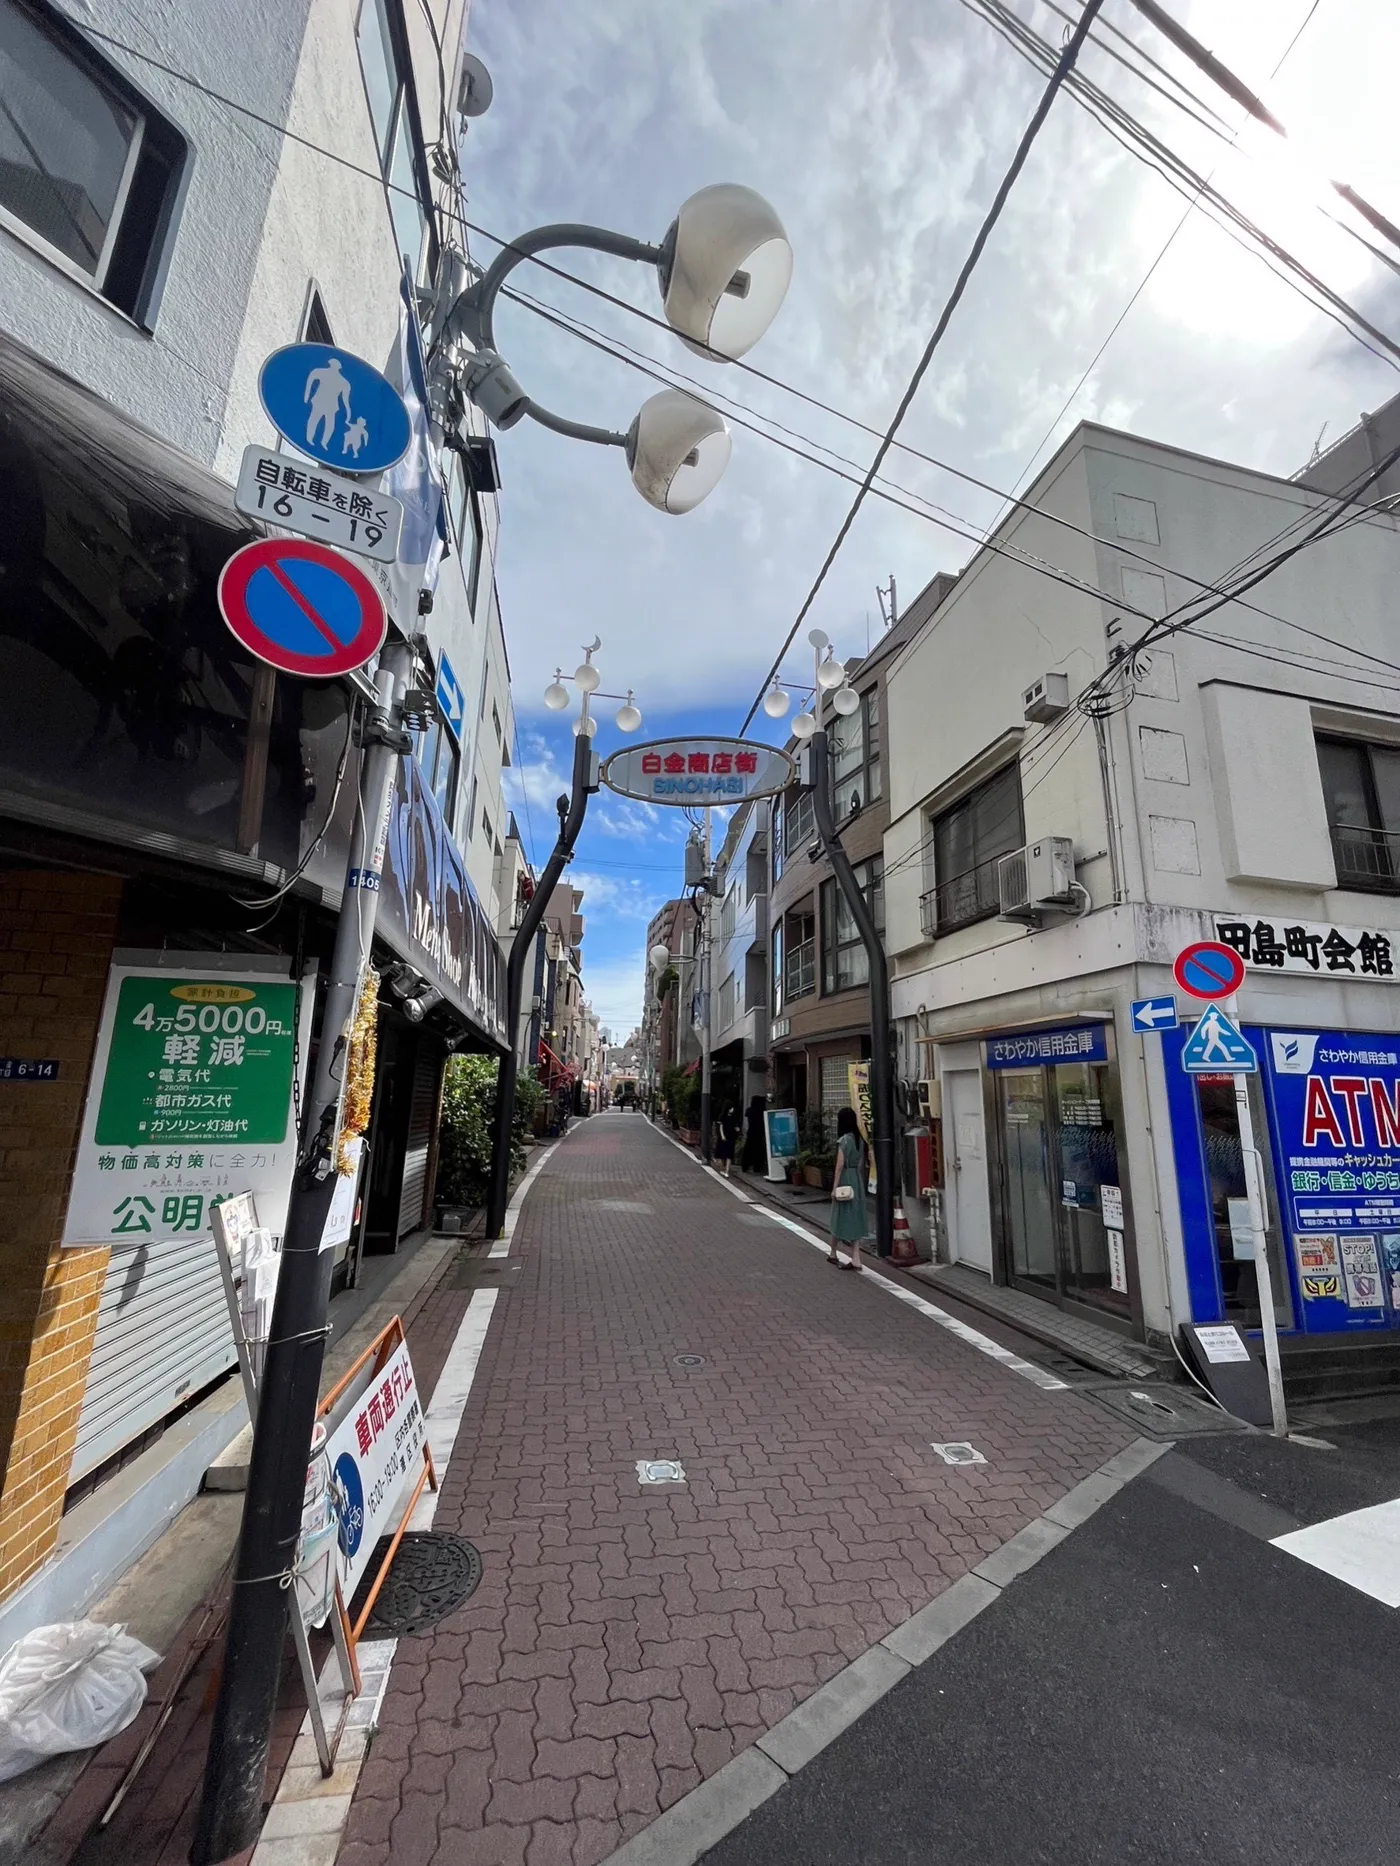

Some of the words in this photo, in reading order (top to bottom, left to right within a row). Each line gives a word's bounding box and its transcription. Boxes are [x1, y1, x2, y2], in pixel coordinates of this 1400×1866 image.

[256, 458, 389, 526] 自転車を除く
[641, 751, 758, 774] 白金商店街
[653, 777, 743, 794] SINOHASI
[351, 875, 380, 890] 1405
[1216, 920, 1393, 976] 田島町会館
[186, 987, 240, 998] 家計負担
[132, 1002, 282, 1036] 4万5000円
[162, 1033, 246, 1066] 軽減
[994, 1031, 1094, 1061] さわやか信用金庫
[1318, 1048, 1398, 1065] さわやか信用金庫
[18, 1064, 52, 1076] 6-14
[158, 1068, 211, 1083] 電気代
[155, 1094, 232, 1108] 都市ガス代
[150, 1119, 249, 1132] ガソリン・灯油代
[1344, 1243, 1375, 1255] STOP!
[354, 1353, 413, 1458] 車両通行止
[367, 1452, 399, 1519] 16:00-19:00
